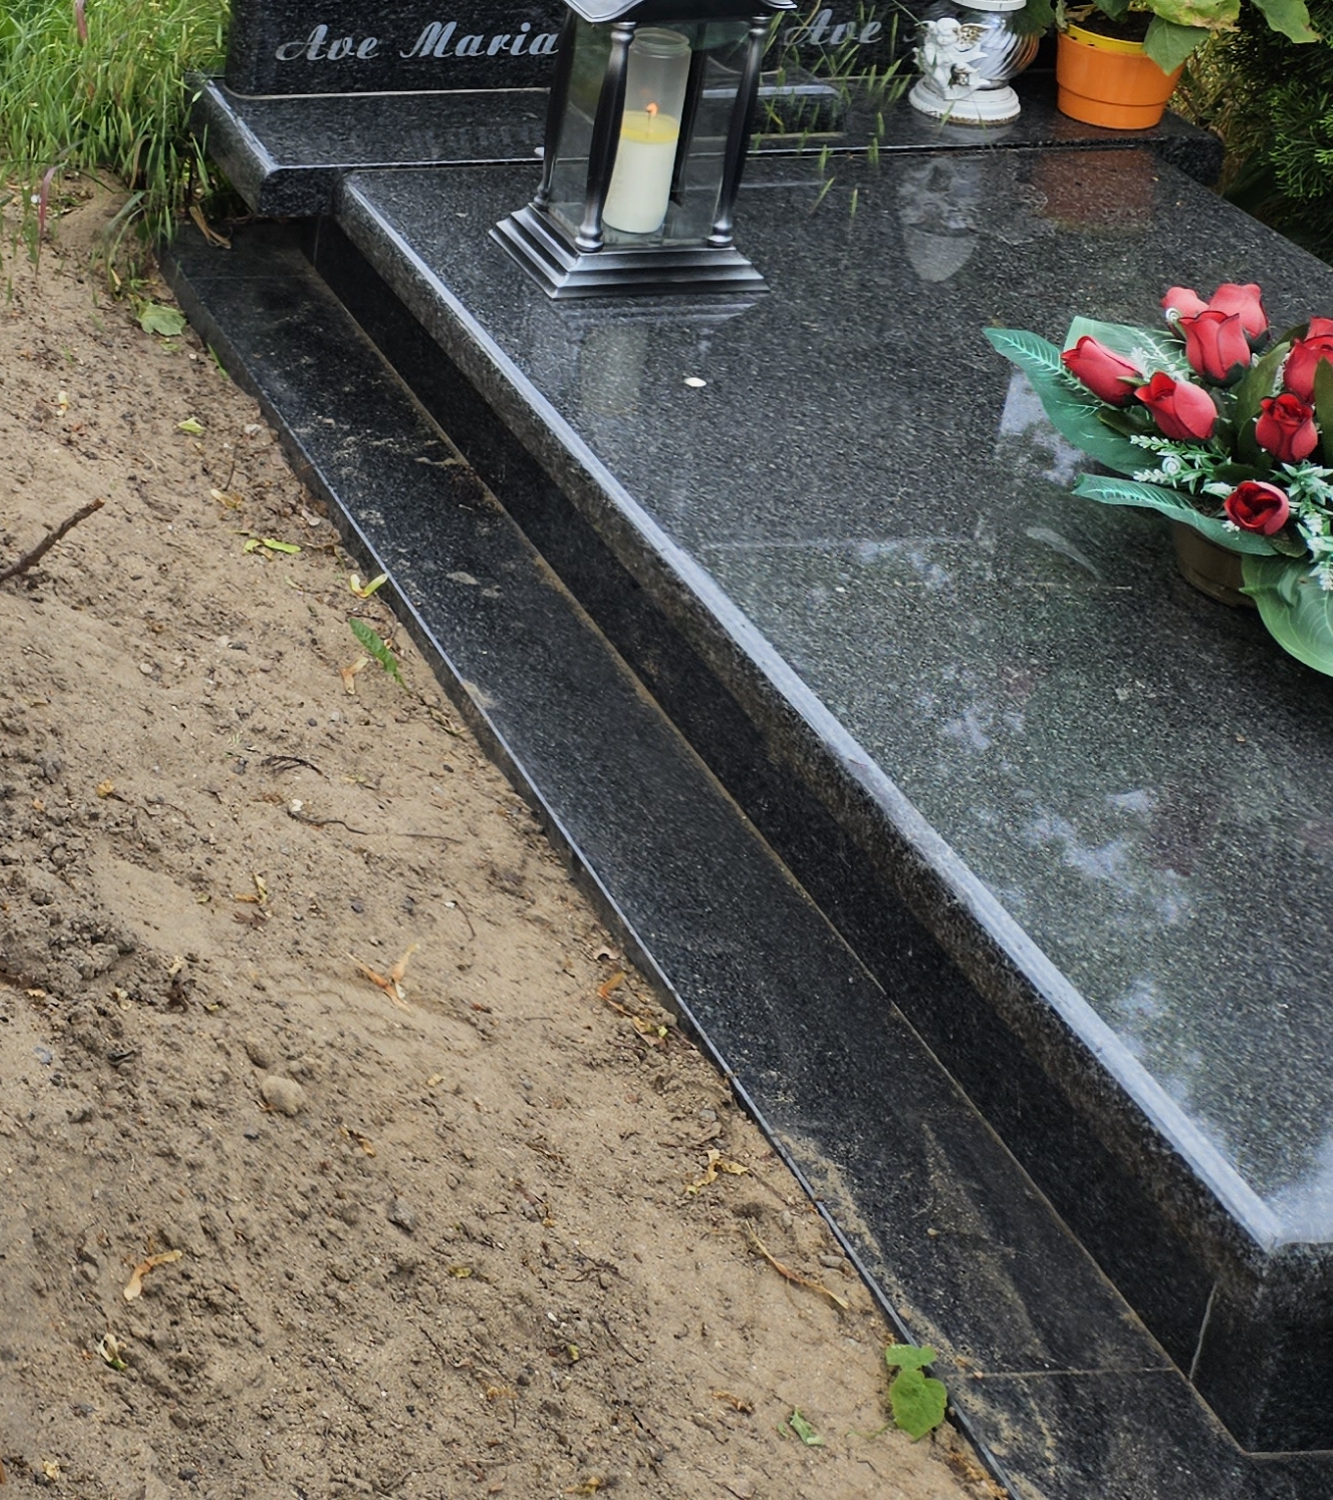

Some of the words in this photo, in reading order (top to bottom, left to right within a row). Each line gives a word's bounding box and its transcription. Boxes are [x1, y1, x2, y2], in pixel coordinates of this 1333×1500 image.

[275, 24, 379, 61] Ave
[399, 21, 559, 58] Maria
[784, 8, 882, 45] Ave
